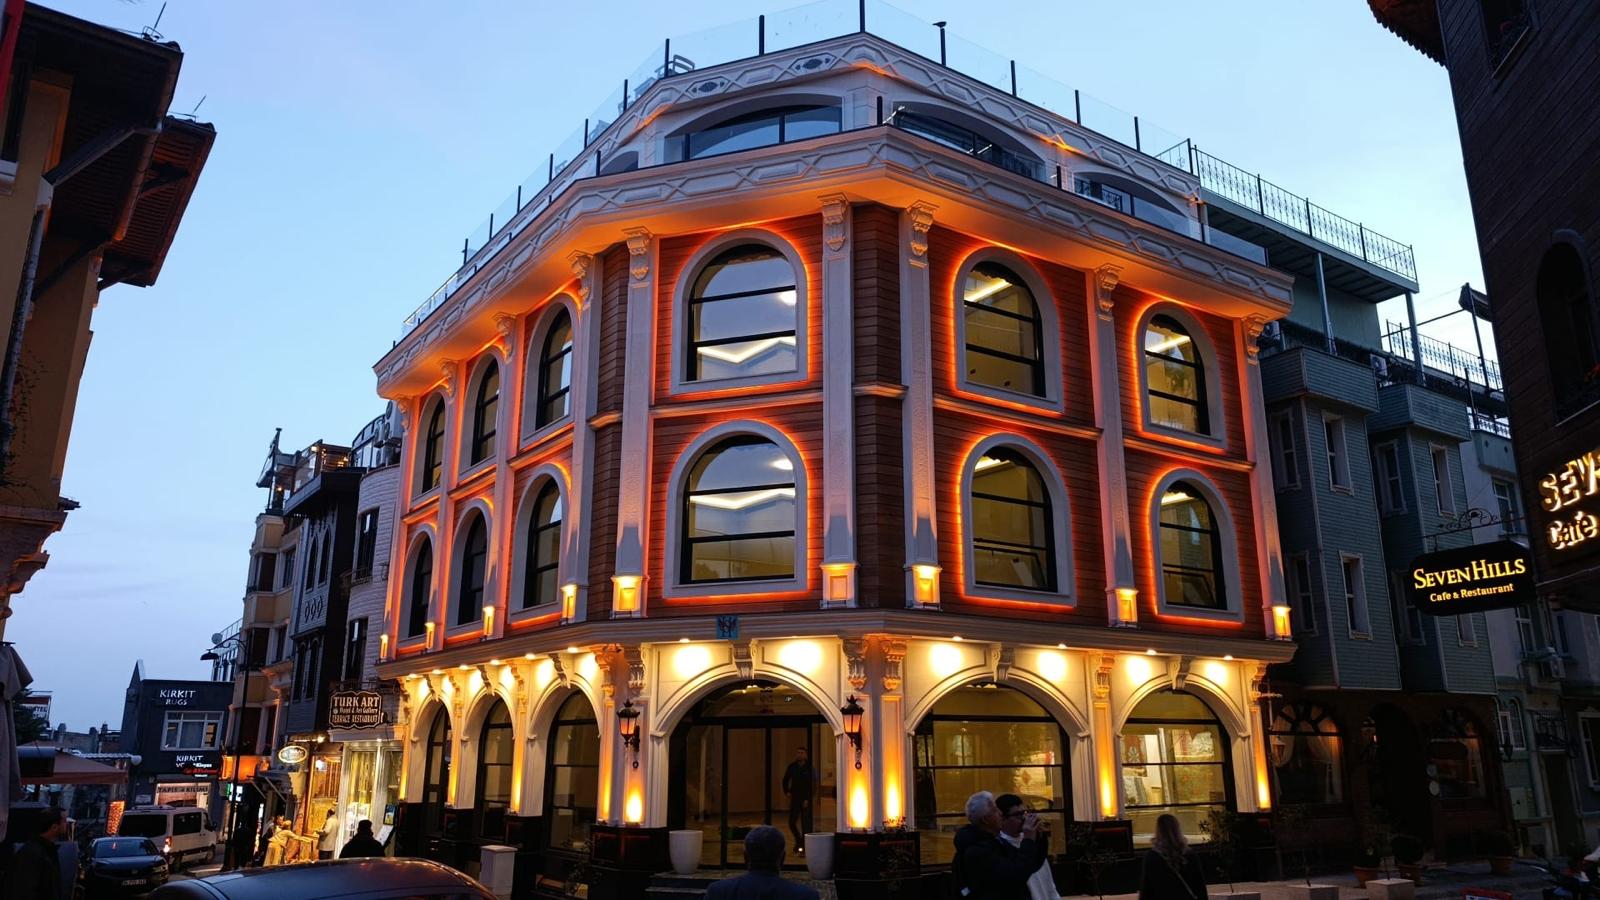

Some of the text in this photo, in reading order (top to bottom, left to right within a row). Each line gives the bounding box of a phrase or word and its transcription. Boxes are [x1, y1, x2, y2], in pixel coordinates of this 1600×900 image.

[1430, 583, 1514, 602] Cafe & Restaurant
[160, 690, 196, 698] KIRKIT
[334, 697, 379, 706] TURK ART
